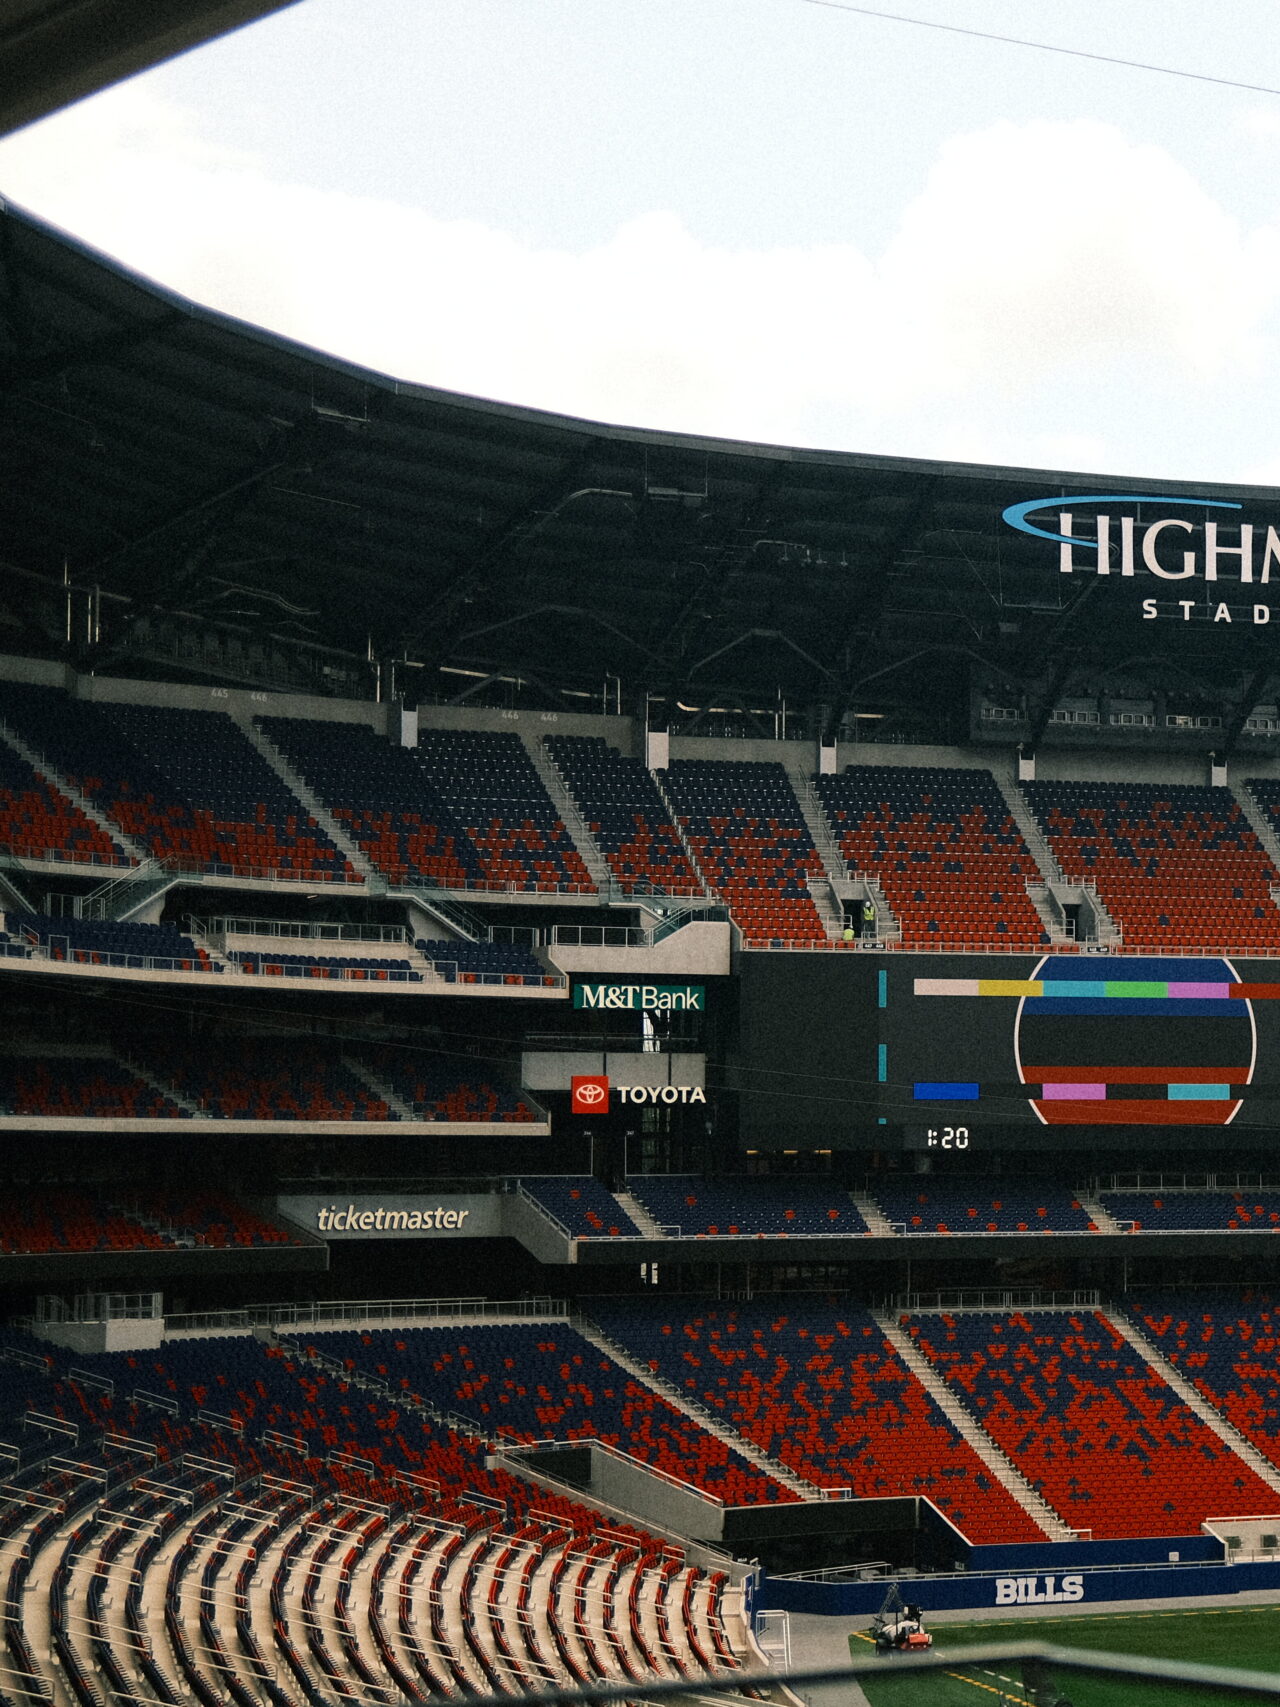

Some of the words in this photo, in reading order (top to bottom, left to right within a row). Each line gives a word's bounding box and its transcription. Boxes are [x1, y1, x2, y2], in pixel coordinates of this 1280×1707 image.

[211, 688, 229, 699] 445
[250, 691, 268, 702] 446
[501, 710, 519, 720] 446
[540, 712, 558, 722] 446
[581, 985, 640, 1009] M&T
[641, 986, 700, 1010] Bank
[617, 1086, 707, 1104] TOYOTA
[927, 1127, 969, 1149] 1:20
[317, 1204, 469, 1231] ticketmaster
[995, 1575, 1084, 1604] BILLS
